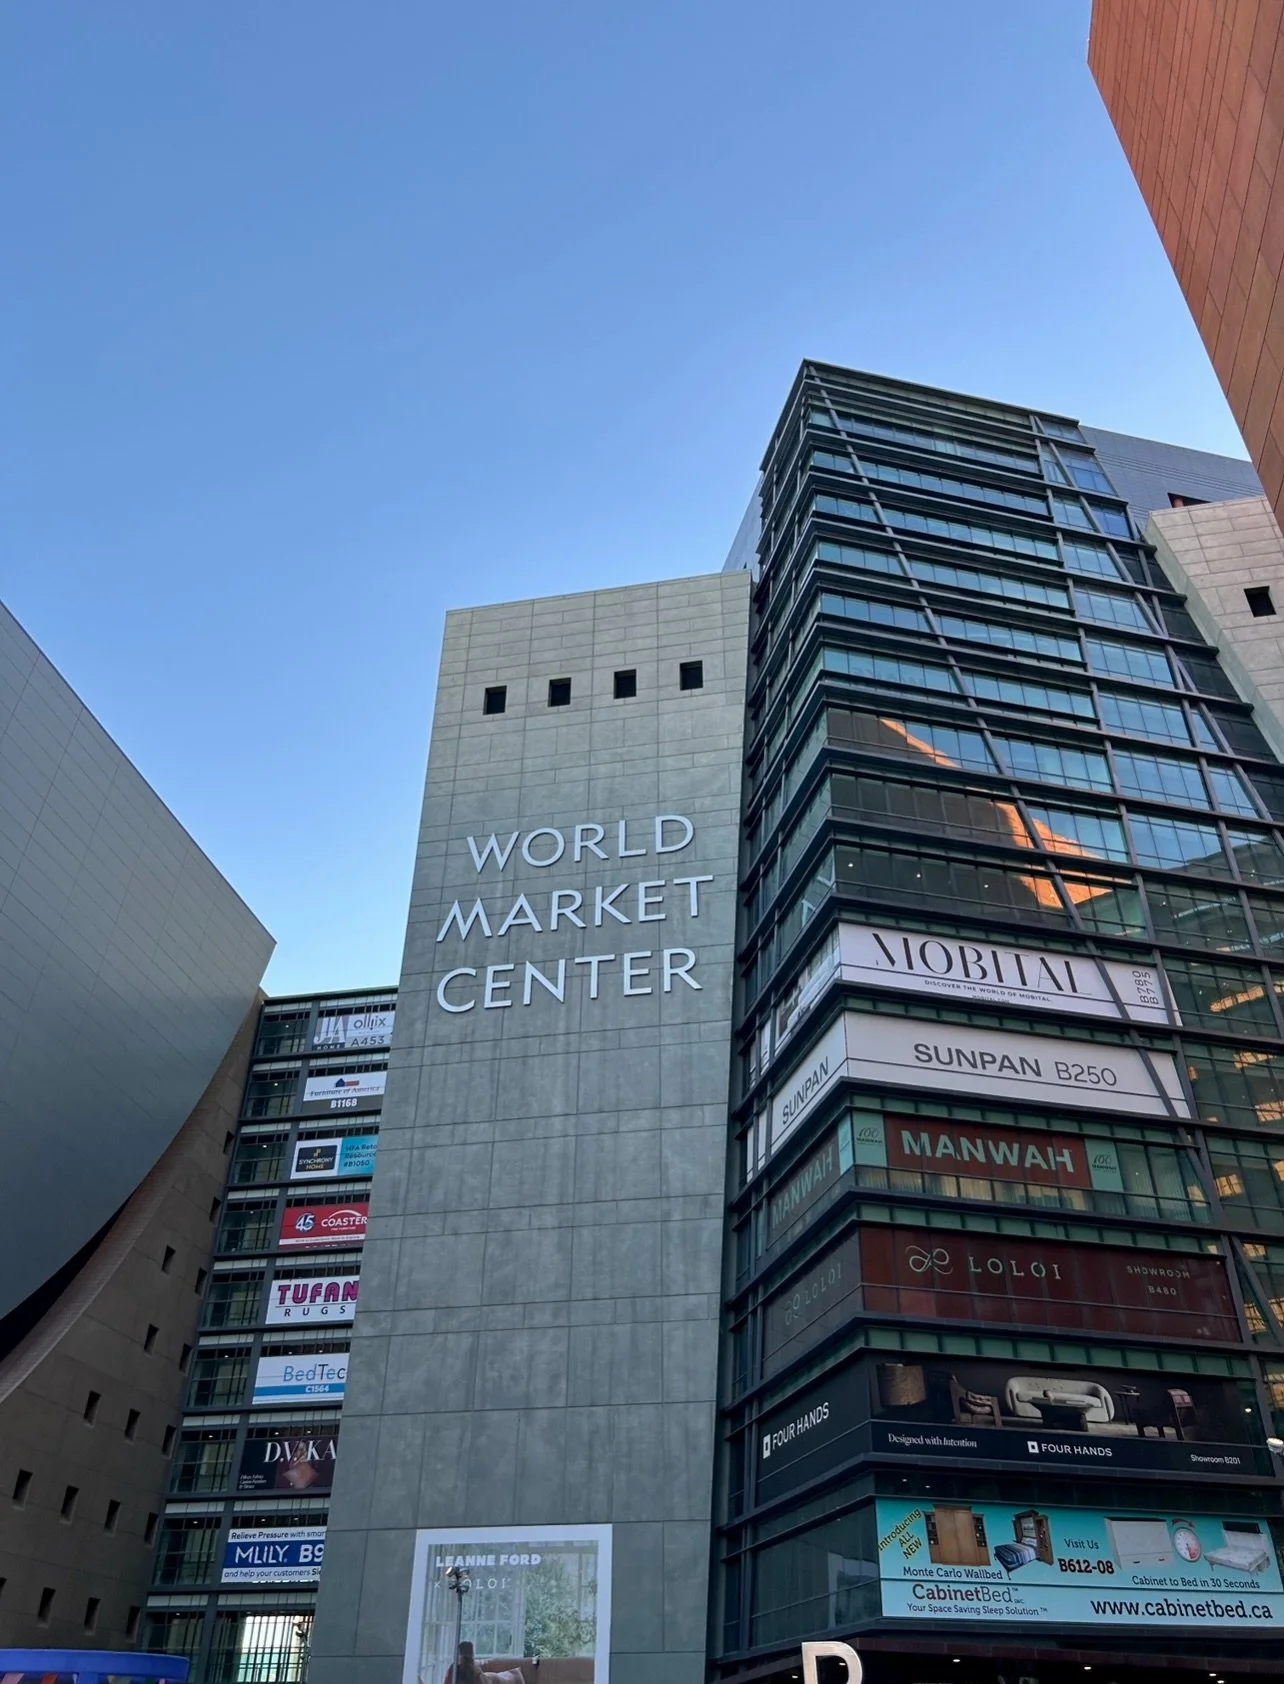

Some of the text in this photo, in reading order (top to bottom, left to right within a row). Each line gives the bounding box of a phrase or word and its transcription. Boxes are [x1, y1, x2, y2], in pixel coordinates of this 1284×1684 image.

[467, 814, 695, 873] WORLD
[436, 874, 714, 943] MARKET
[872, 932, 1092, 996] MOBITAL
[437, 947, 703, 1013] CENTER
[924, 979, 961, 990] DISCOVER
[963, 984, 977, 993] THE
[979, 987, 1006, 996] WORLD
[1019, 993, 1051, 1002] MOBITAL
[351, 1035, 385, 1048] A453
[914, 1042, 1118, 1087] SUNPAN B250
[310, 1088, 343, 1097] Furniture
[782, 1055, 829, 1126] SUNPAN
[901, 1129, 1074, 1173] MANWAH
[298, 1157, 334, 1165] SYNCHRONY
[772, 1146, 833, 1229] MANWAH
[321, 1216, 368, 1228] COASTER
[968, 1255, 1063, 1281] LOLOI
[1126, 1265, 1190, 1279] SHOWROOM
[278, 1280, 359, 1305] TUFAN
[284, 1304, 346, 1317] RUGS
[283, 1363, 346, 1382] BedTec
[772, 1402, 830, 1451] FOUR HANDS
[888, 1432, 978, 1448] Designed with Intention
[1041, 1443, 1113, 1457] FOUR HANDS
[1190, 1454, 1225, 1464] Showroom
[231, 1532, 256, 1540] Relieve
[257, 1531, 289, 1539] Pressure
[289, 1530, 306, 1538] with
[877, 1508, 922, 1551] Introducing
[898, 1531, 915, 1548] ALL
[1063, 1538, 1099, 1550] Visit Us
[903, 1538, 923, 1560] NEW
[436, 1553, 542, 1568] LEANNE FORD
[1057, 1558, 1115, 1575] B612-08
[224, 1570, 239, 1578] and
[239, 1570, 255, 1578] help
[273, 1569, 311, 1577] customers
[903, 1566, 1003, 1580] Monte Carlo Wallbed
[1132, 1575, 1261, 1589] Cabinet to Bed in 30 Seconds
[907, 1602, 926, 1613] Your
[928, 1603, 952, 1615] Space
[953, 1604, 981, 1615] Saving
[982, 1605, 1004, 1616] Sleep
[1090, 1598, 1273, 1620] www.cabinetbed.ca
